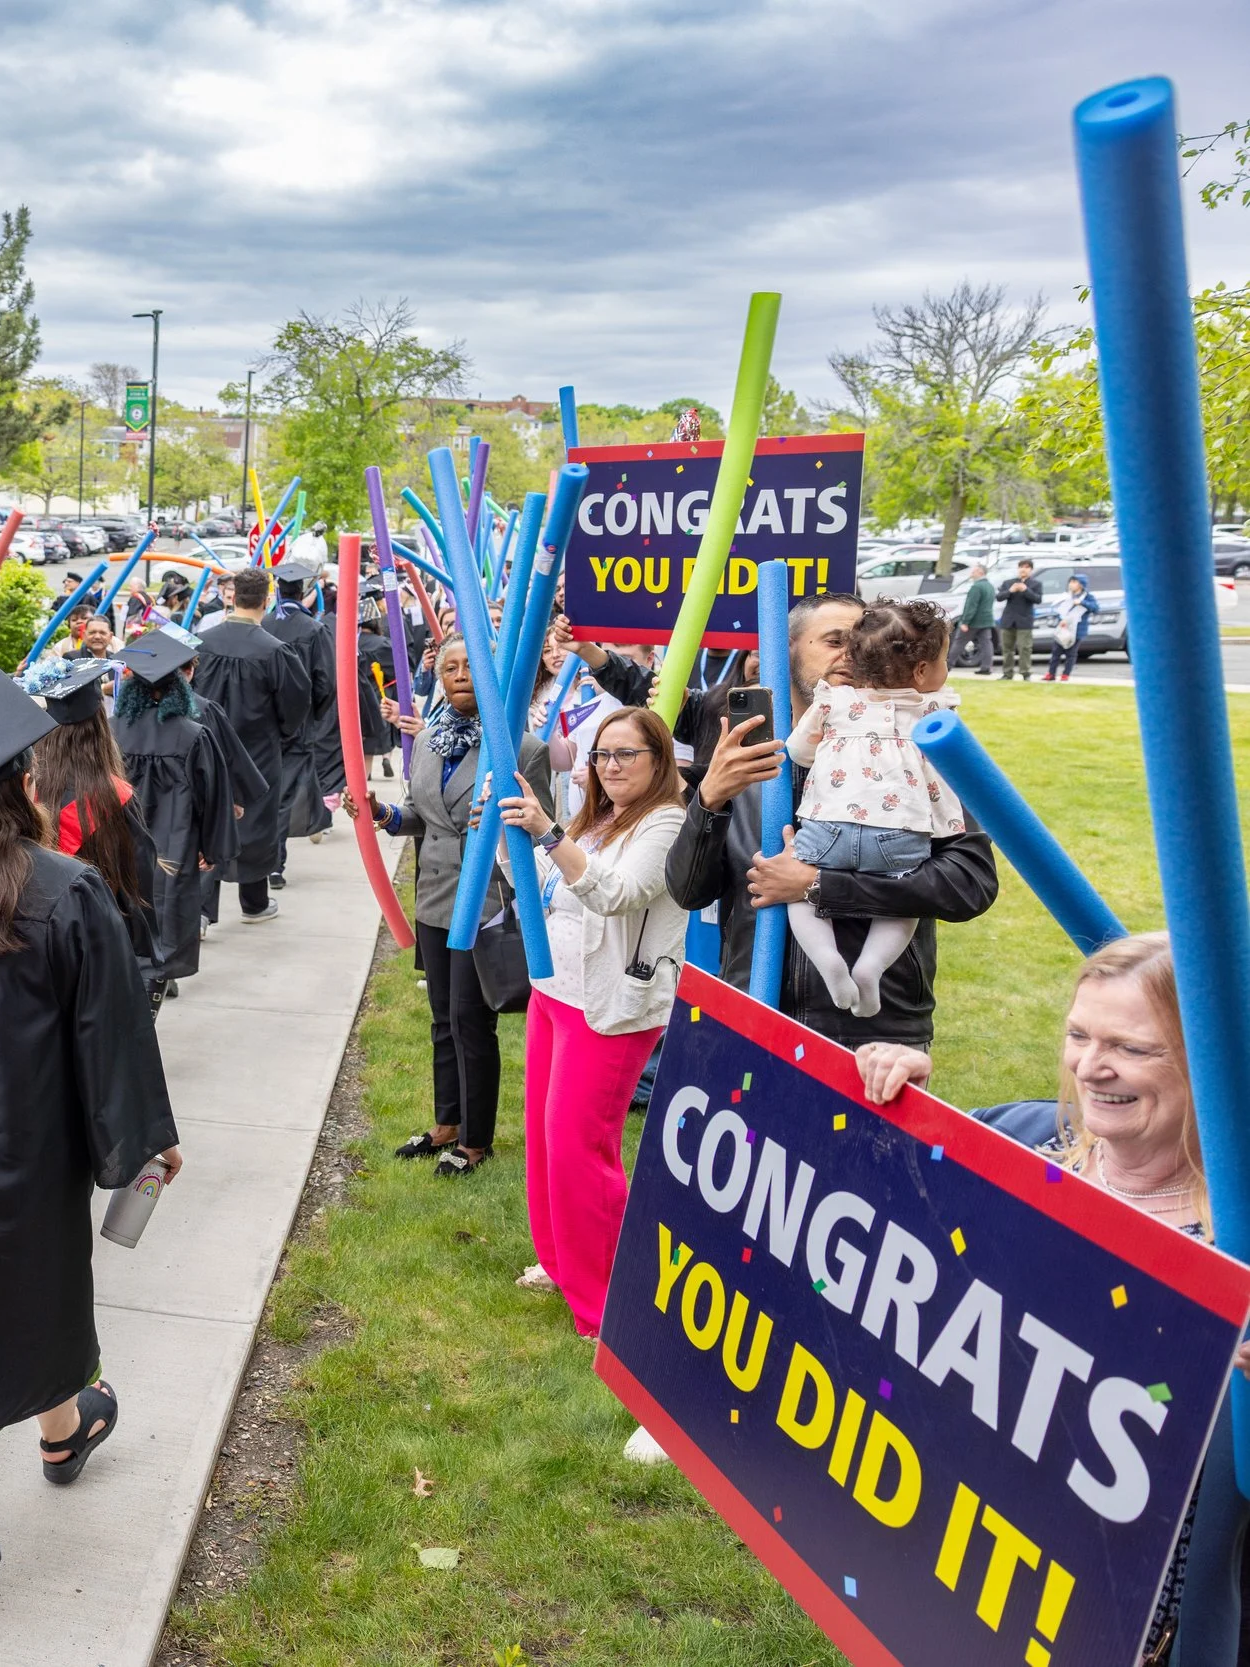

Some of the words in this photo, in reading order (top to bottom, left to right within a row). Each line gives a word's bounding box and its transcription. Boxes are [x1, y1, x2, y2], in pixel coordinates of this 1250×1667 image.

[250, 534, 285, 555] SP
[589, 556, 670, 594] YOU
[774, 557, 830, 596] T!
[662, 1085, 1168, 1523] CONGRATS
[653, 1221, 774, 1394] YOU
[776, 1341, 922, 1530] DID
[934, 1481, 1076, 1667] IT!
